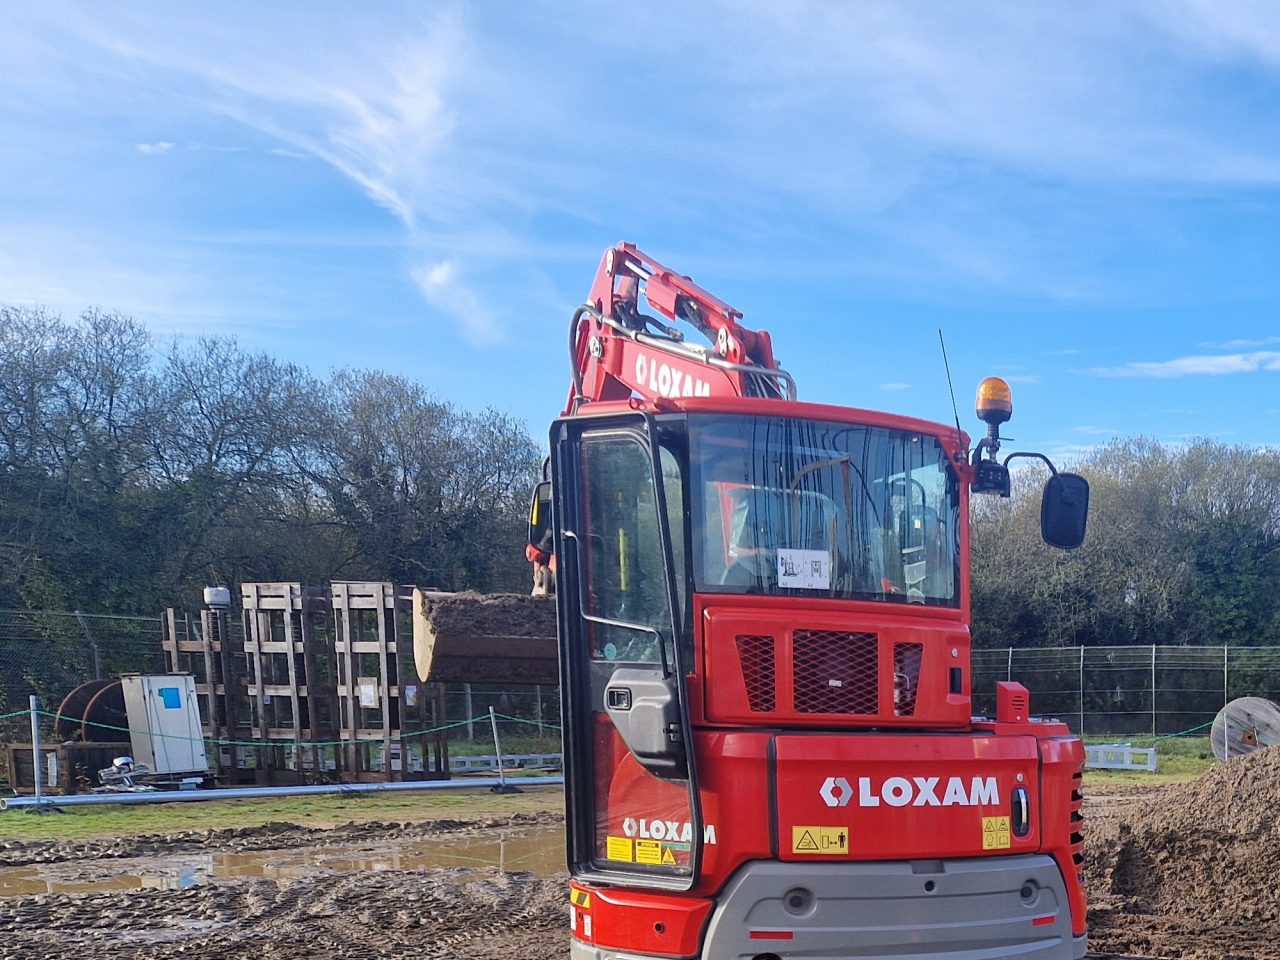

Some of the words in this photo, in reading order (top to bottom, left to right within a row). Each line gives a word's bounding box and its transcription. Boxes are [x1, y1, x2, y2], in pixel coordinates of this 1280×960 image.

[649, 358, 711, 398] LOXAM
[858, 776, 1000, 807] LOXAM
[639, 819, 717, 845] LOXAM
